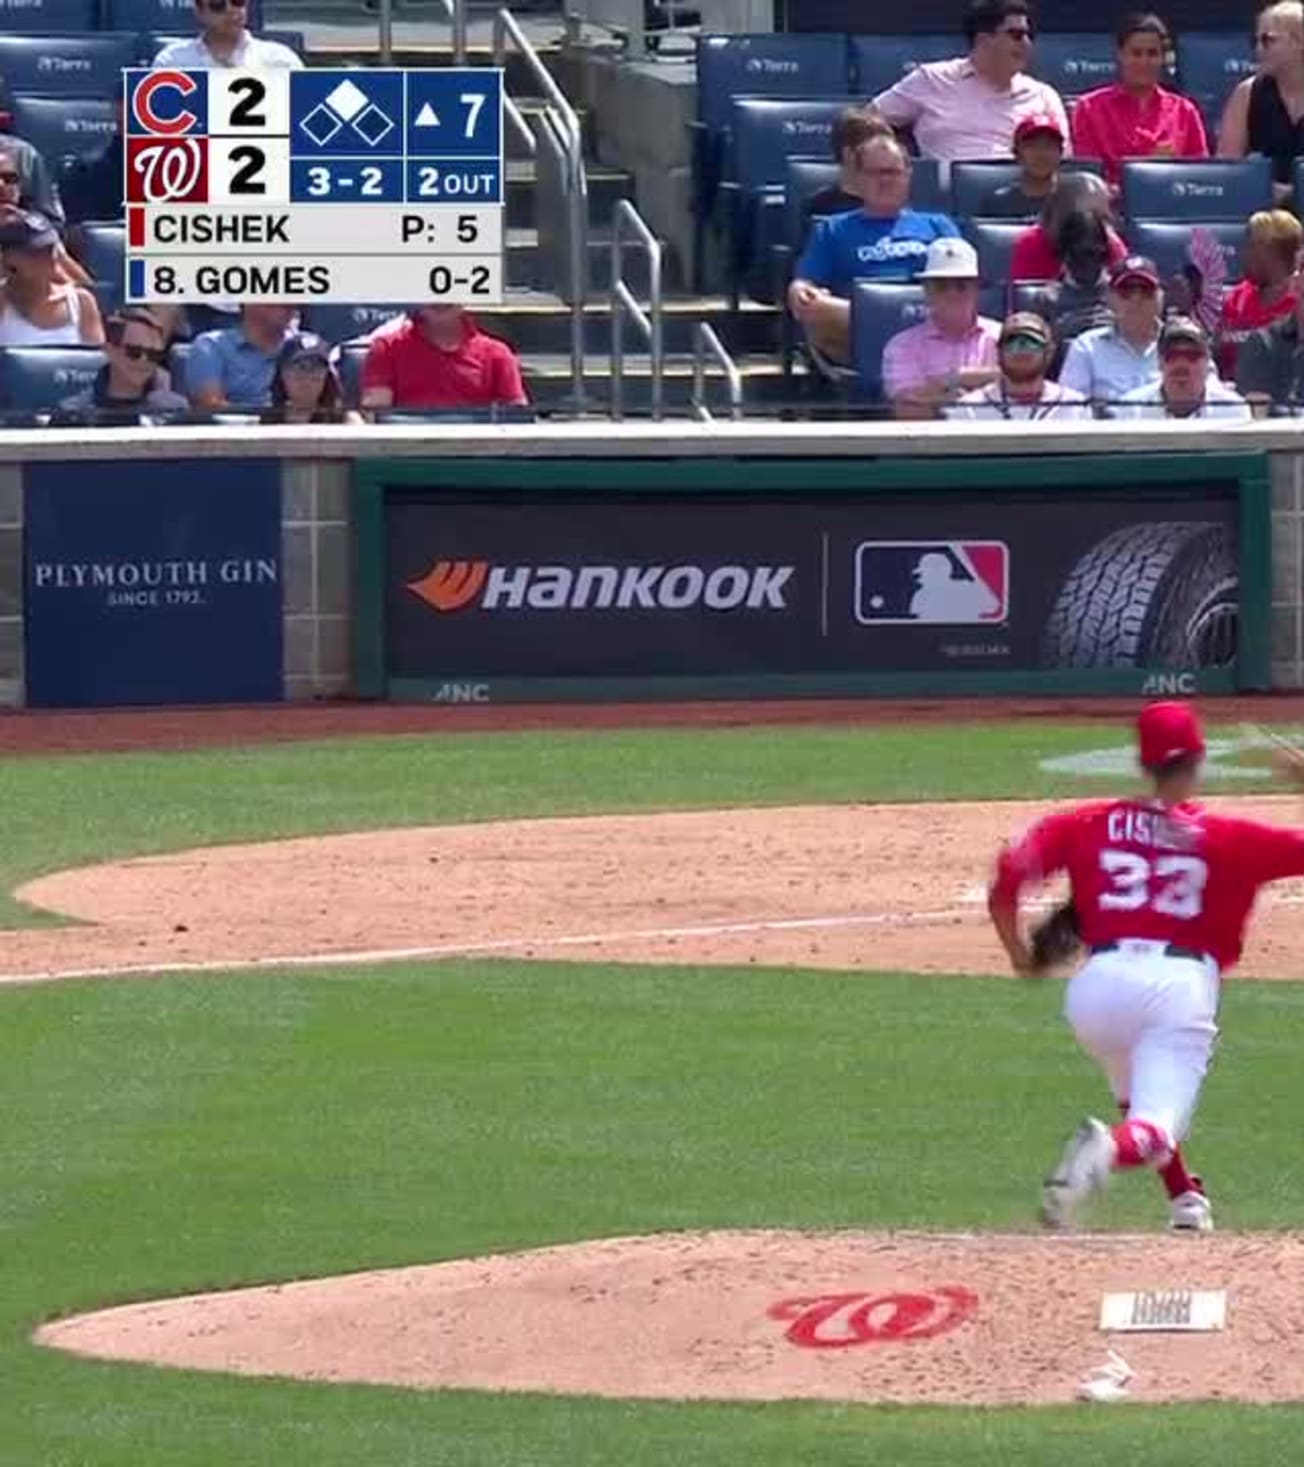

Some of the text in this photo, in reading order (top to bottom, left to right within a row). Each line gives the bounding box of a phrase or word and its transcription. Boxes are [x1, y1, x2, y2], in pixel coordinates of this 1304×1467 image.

[36, 559, 277, 588] PLYMOUTH GIN
[108, 591, 158, 606] SINCE
[434, 684, 490, 702] ANC
[1143, 673, 1196, 694] ANC
